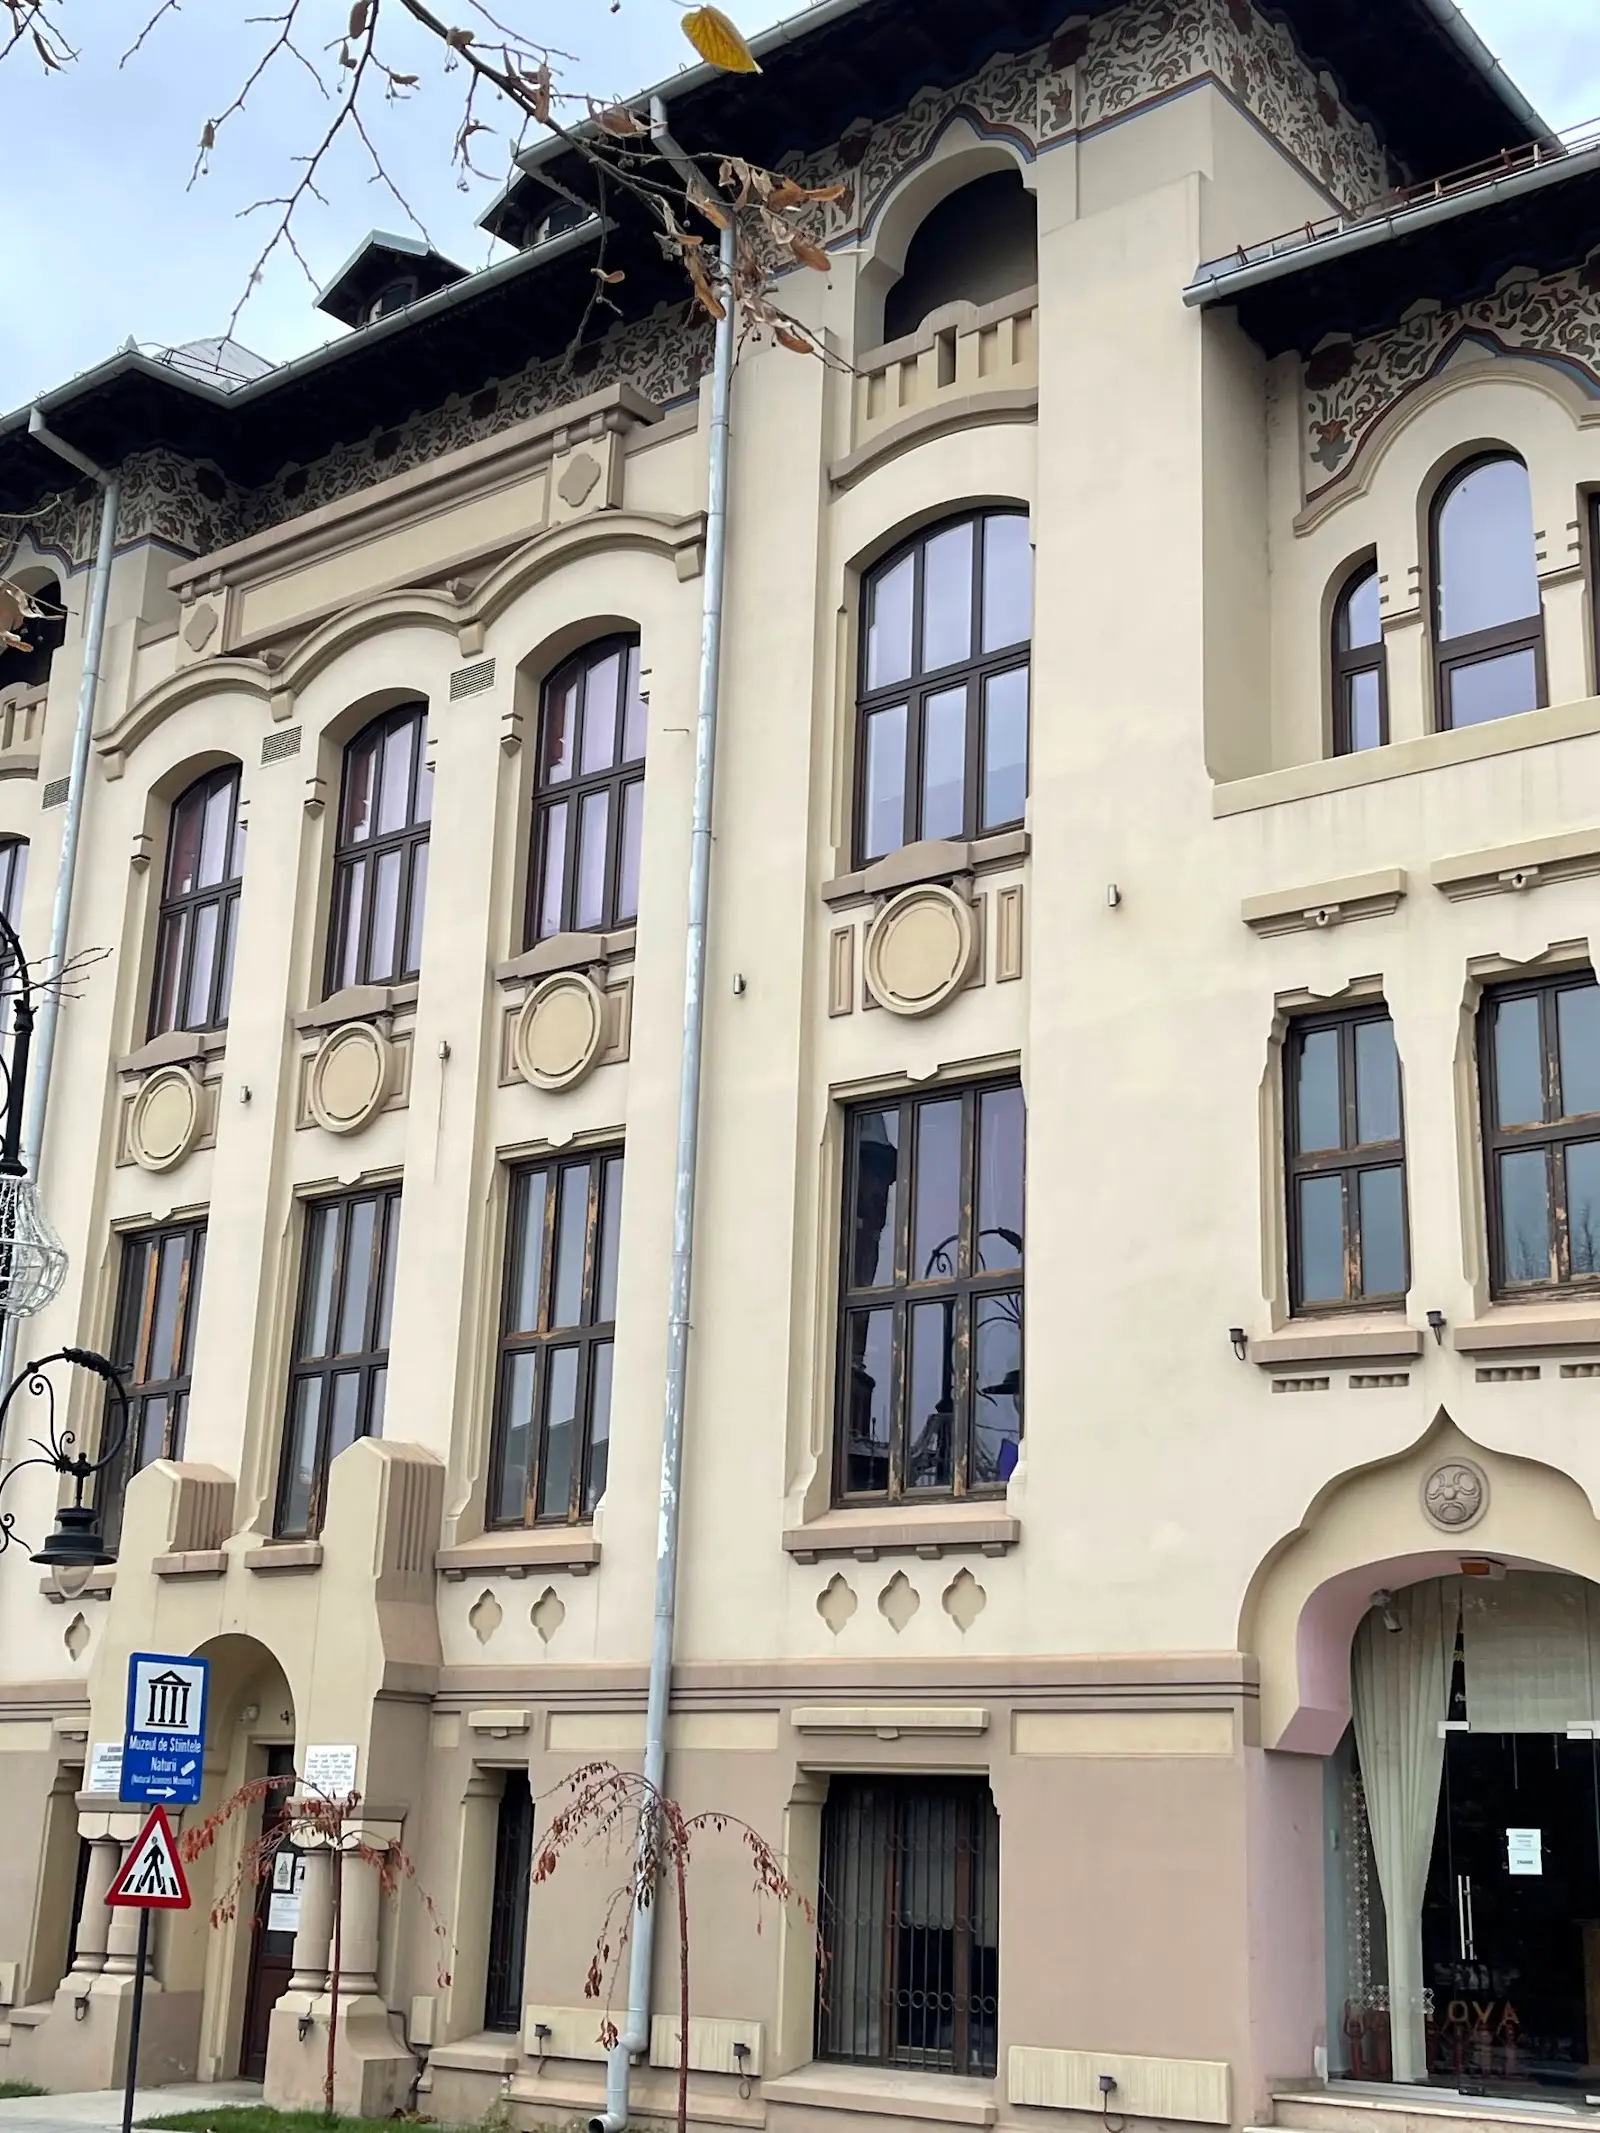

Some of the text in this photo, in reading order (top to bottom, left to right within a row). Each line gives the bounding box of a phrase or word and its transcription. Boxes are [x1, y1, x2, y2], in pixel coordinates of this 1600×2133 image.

[129, 1735, 157, 1751] Muzeul
[157, 1737, 168, 1752] de
[151, 1757, 178, 1772] Naturii
